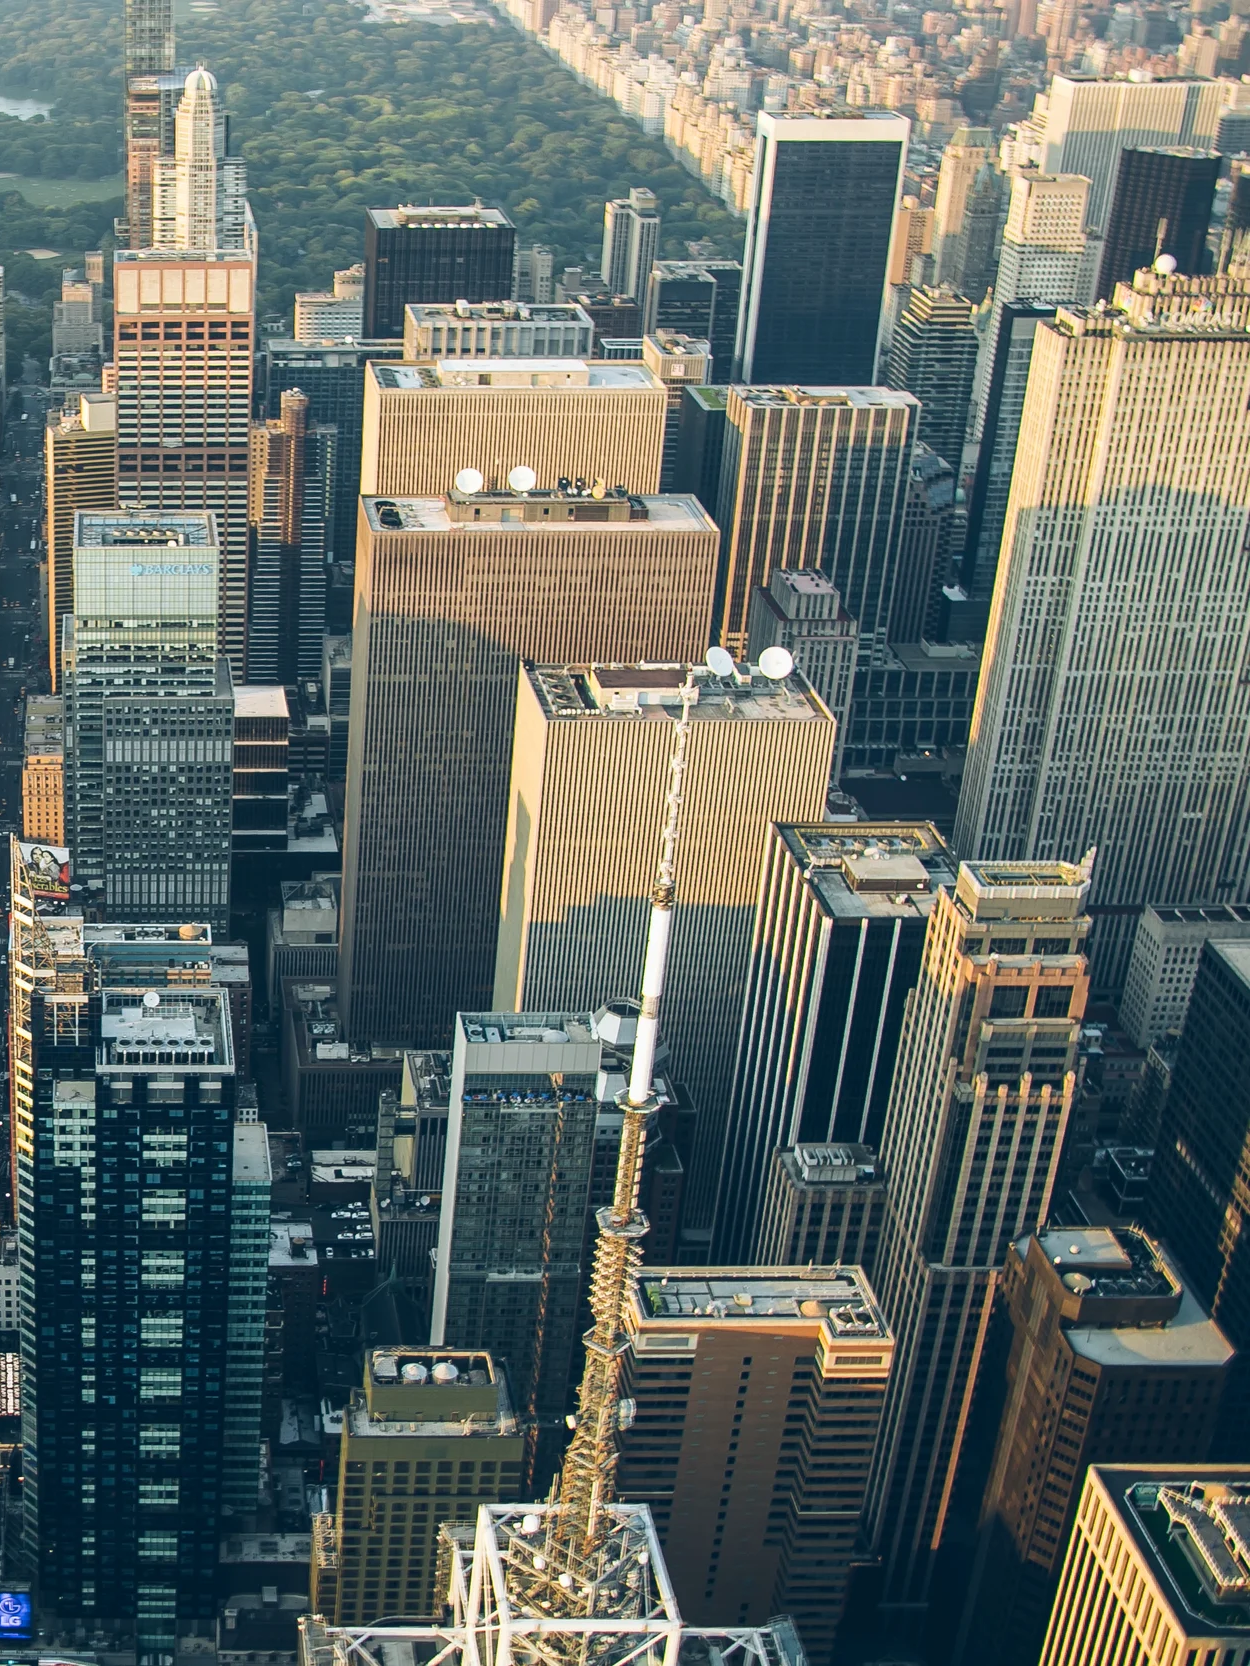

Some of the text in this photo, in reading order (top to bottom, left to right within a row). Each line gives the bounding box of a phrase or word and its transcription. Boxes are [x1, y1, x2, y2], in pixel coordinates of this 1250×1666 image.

[1160, 312, 1241, 326] COMCAST
[145, 564, 214, 575] BARCLAYS
[0, 1616, 22, 1626] LG
